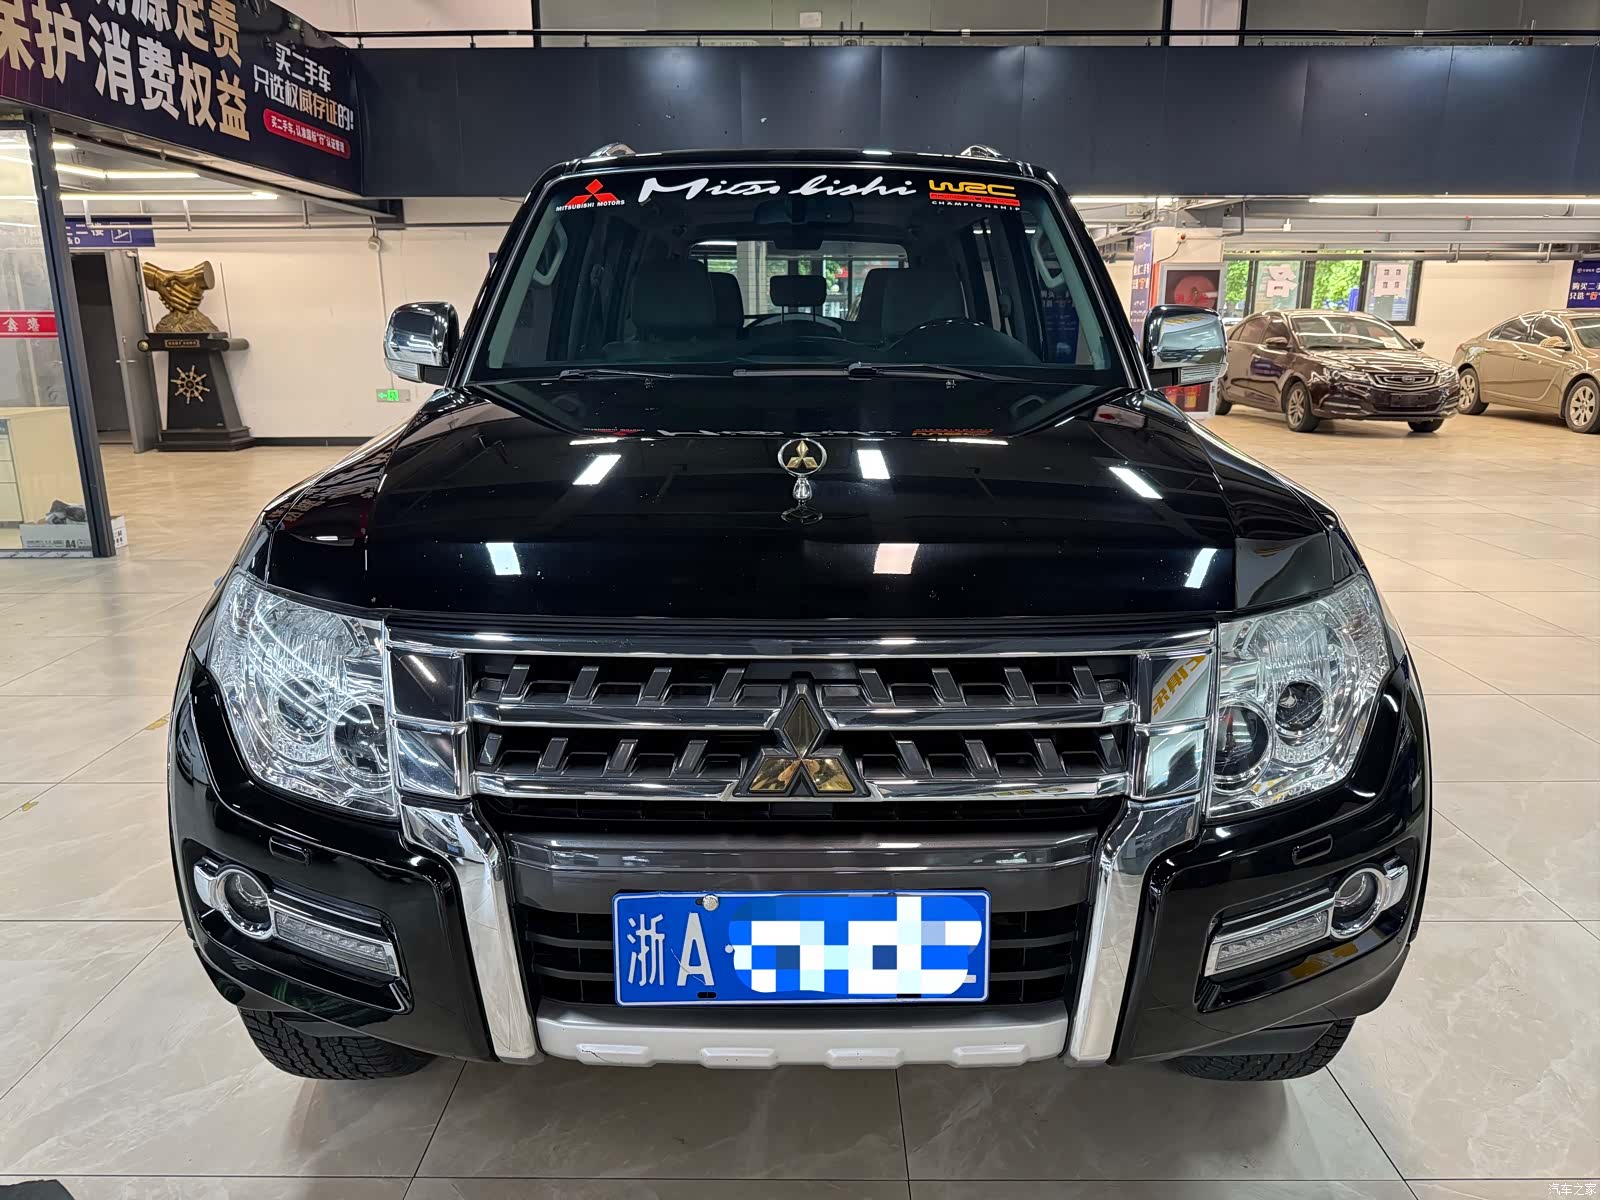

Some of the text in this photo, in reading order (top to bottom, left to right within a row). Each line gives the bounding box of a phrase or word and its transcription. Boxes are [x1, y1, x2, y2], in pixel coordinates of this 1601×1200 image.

[275, 42, 331, 93] 买二手车
[929, 180, 1016, 197] WRC
[556, 202, 595, 211] MITSUBISHI
[931, 200, 1020, 211] CHAMPIONSHIP
